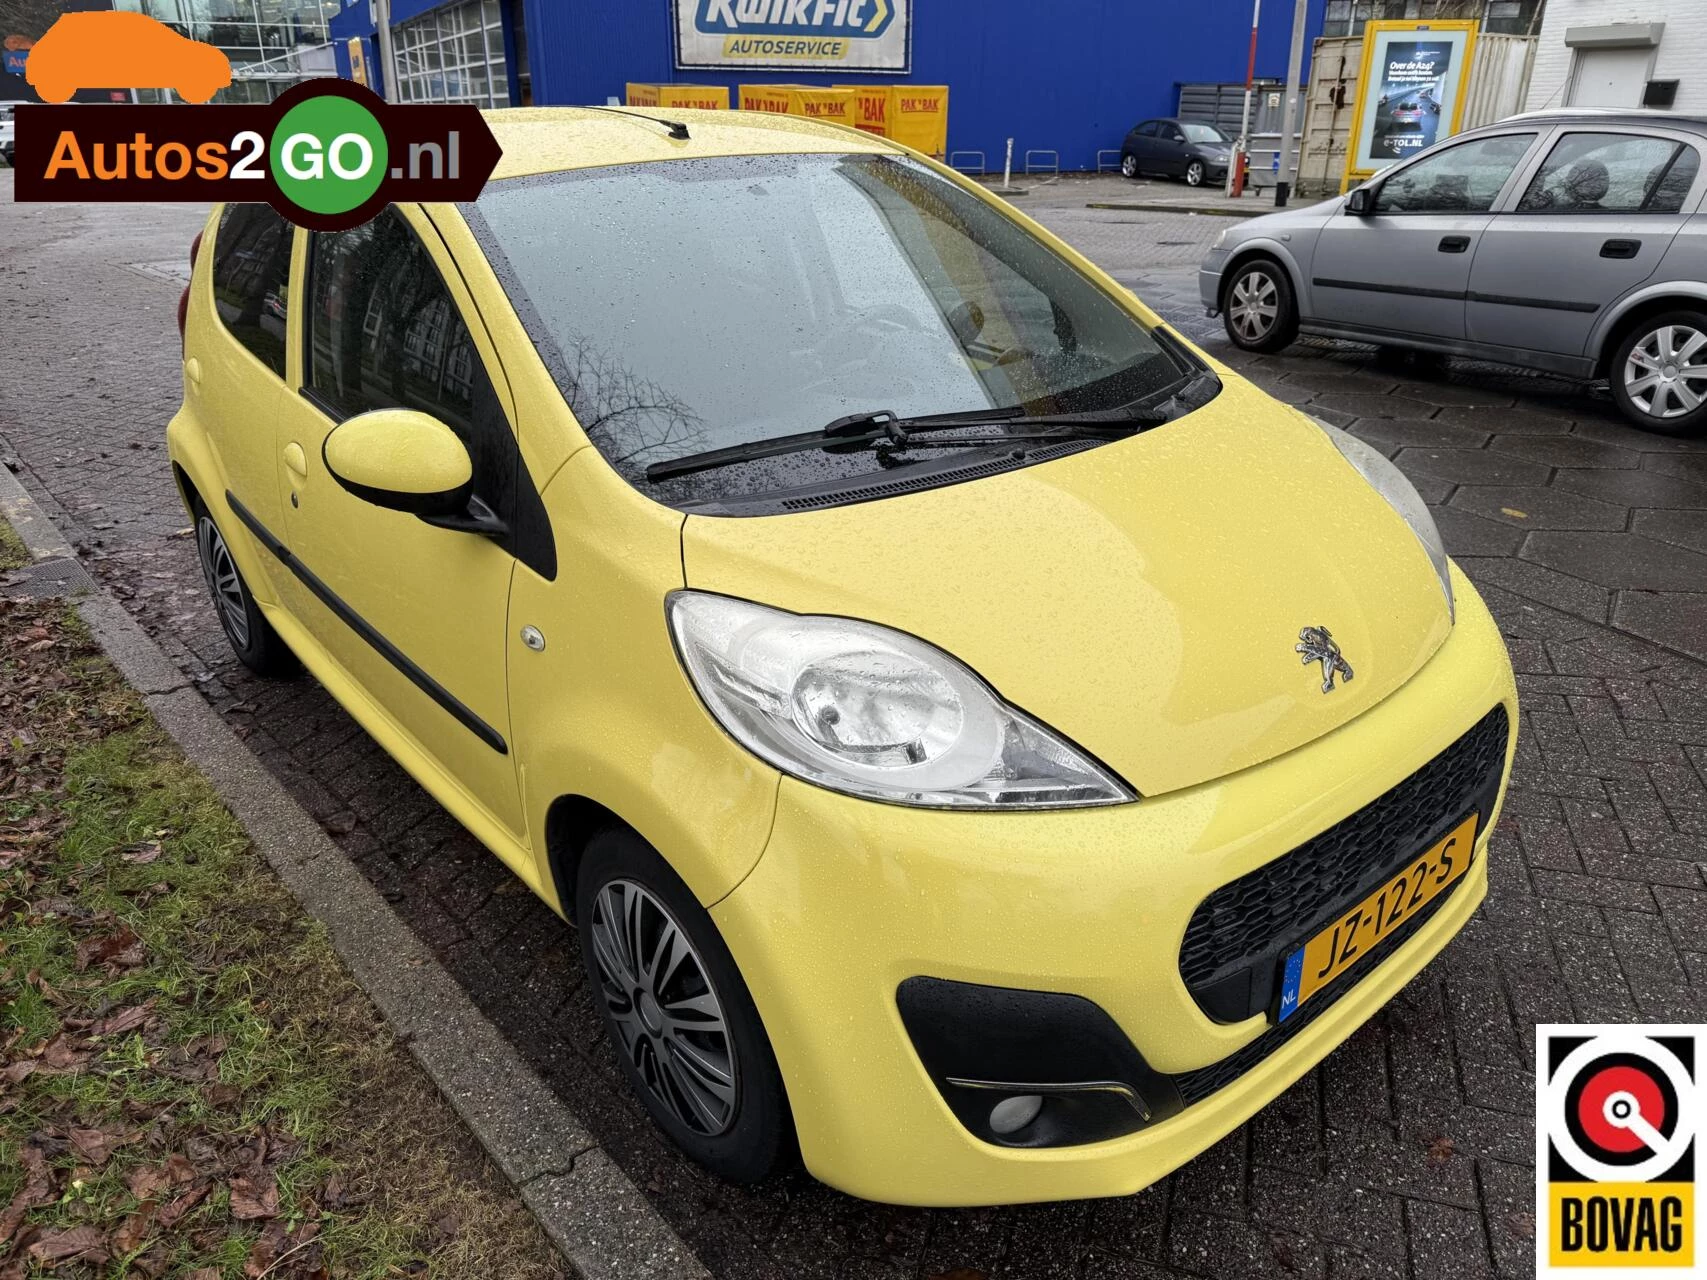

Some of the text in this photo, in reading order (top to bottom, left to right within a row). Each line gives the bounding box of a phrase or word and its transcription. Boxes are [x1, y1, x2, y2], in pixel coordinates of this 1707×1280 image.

[729, 40, 842, 55] AUTOSERVICE
[864, 97, 885, 122] BAK
[1318, 837, 1457, 979] JZ-122-S
[1281, 989, 1296, 1009] NL
